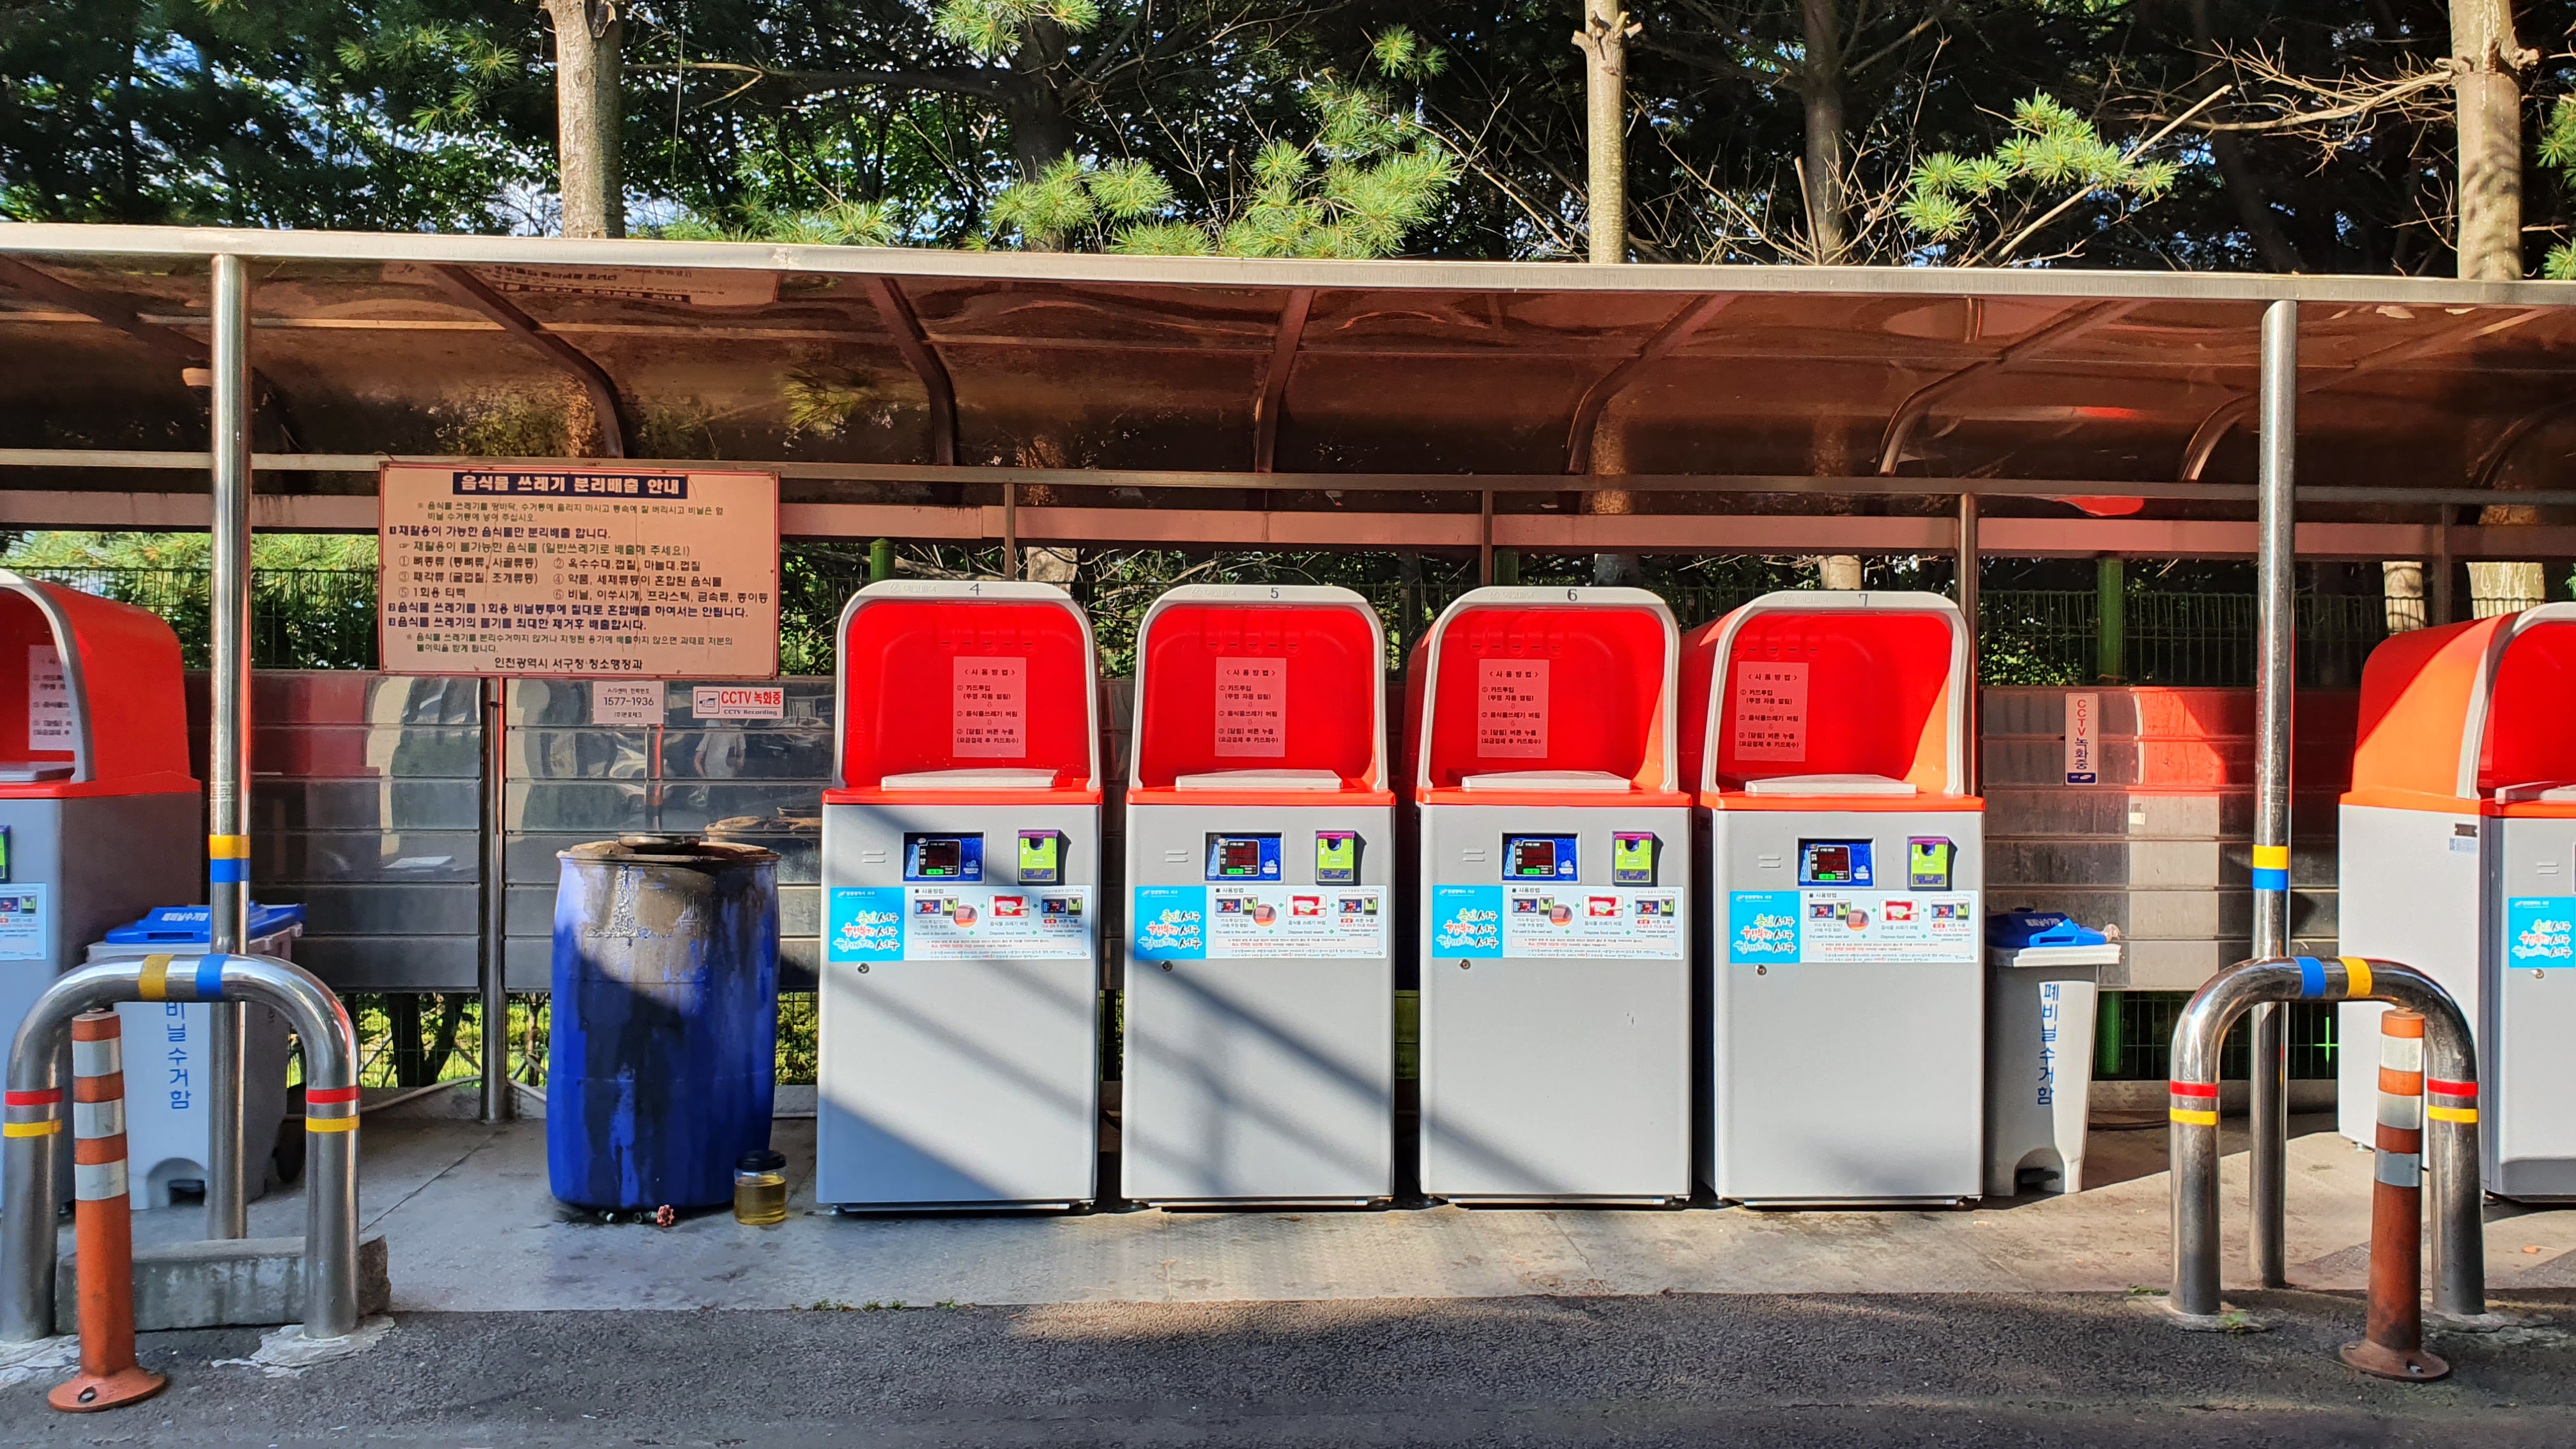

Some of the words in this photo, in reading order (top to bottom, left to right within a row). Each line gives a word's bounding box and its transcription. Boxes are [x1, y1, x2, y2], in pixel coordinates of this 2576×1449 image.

[461, 475, 509, 491] 음식물
[517, 476, 565, 491] 쓰레기
[574, 477, 639, 493] 분리배출
[647, 479, 679, 494] 안내
[427, 502, 452, 510] 음식물
[456, 502, 487, 510] 쓰레기를
[585, 504, 610, 512] 마시고
[652, 505, 684, 514] 버리시고
[483, 513, 498, 522] 넣어
[399, 525, 441, 537] 재활용이
[446, 526, 478, 537] 가능한
[482, 526, 524, 538] 음식물만
[528, 527, 571, 539] 분리배출
[576, 528, 611, 539] 합니다.
[413, 540, 456, 552] 재활용이
[461, 542, 502, 553] 불가능한
[506, 542, 537, 553] 음식물
[655, 576, 686, 586] 혼합된
[691, 576, 722, 587] 음식물
[413, 587, 440, 599] 1회용
[445, 587, 466, 599] 티백
[569, 589, 592, 601] 비닐,
[969, 583, 982, 596] 4
[1270, 587, 1279, 599] 5
[1567, 588, 1577, 601] 6
[1859, 594, 1868, 607] 7
[398, 602, 429, 613] 음식물
[434, 602, 476, 613] 쓰레기를
[481, 603, 509, 615] 1회용
[514, 604, 567, 615] 비닐봉투에
[572, 604, 604, 616] 절대로
[608, 605, 650, 617] 혼합배출
[655, 606, 698, 617] 하여서는
[398, 617, 429, 627] 음식물
[434, 617, 476, 628] 쓰레기의
[516, 618, 549, 629] 최대한
[553, 618, 584, 629] 제거후
[652, 636, 677, 645] 않으면
[494, 657, 548, 669] 인천광역시
[553, 658, 583, 670] 서구청
[589, 659, 643, 670] 청소행정과
[604, 697, 654, 706] 1577-1936
[721, 691, 751, 704] CCTV
[754, 691, 781, 705] 녹화중
[2037, 983, 2060, 1105] 폐비닐수거함
[165, 1002, 192, 1110] 비닐수거함
